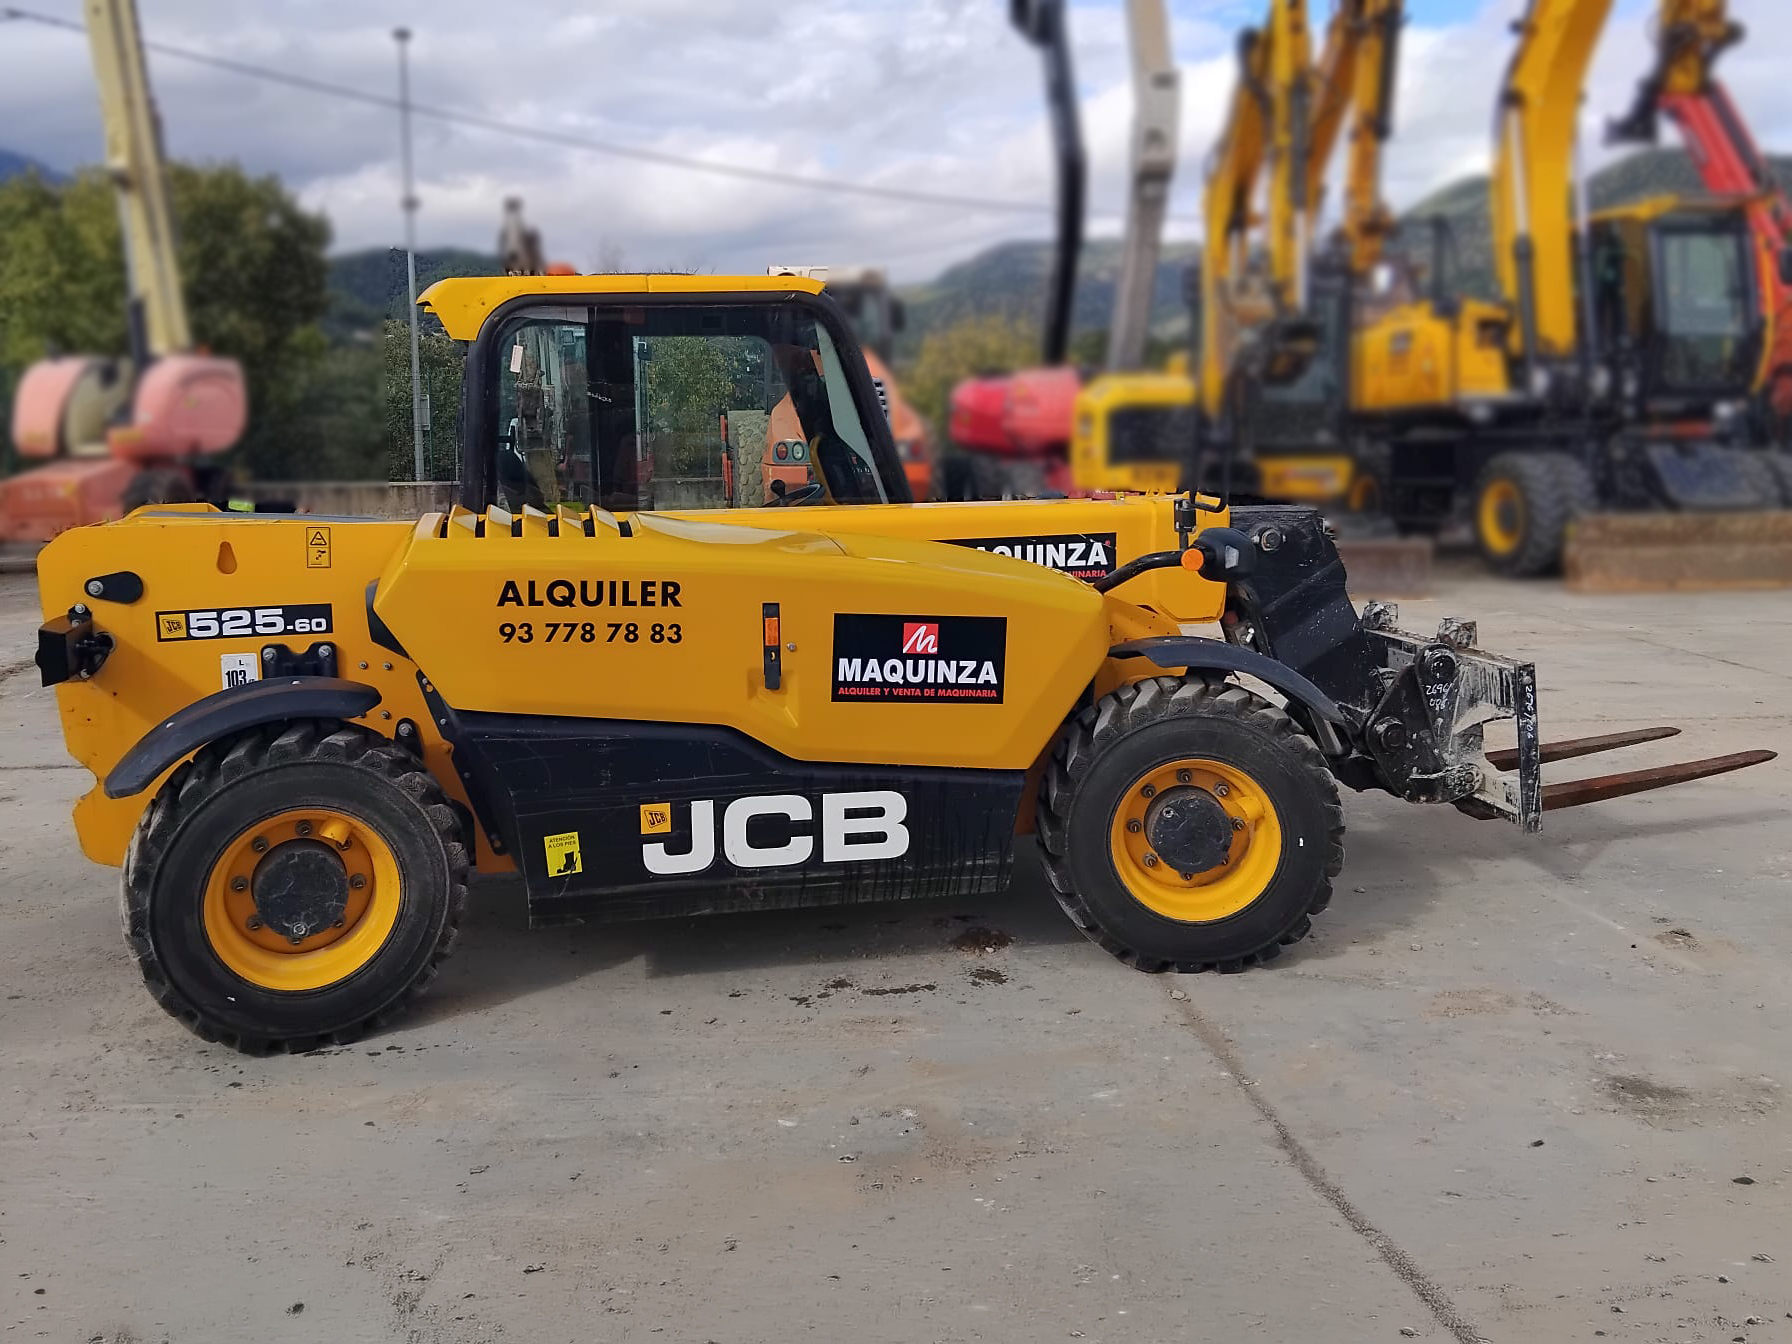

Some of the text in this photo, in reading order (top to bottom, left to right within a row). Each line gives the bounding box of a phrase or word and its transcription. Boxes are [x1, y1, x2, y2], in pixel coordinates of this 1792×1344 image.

[976, 542, 1108, 568] UINZA
[496, 579, 682, 608] ALQUILER
[189, 608, 327, 638] 525-60
[498, 622, 683, 644] 93 778 78 83
[225, 669, 247, 687] 103
[838, 657, 998, 684] MAQUINZA
[838, 687, 998, 698] ALQUILER Y VENTA DE MAQUINARIA
[648, 811, 666, 826] JCB
[642, 790, 910, 875] JCB
